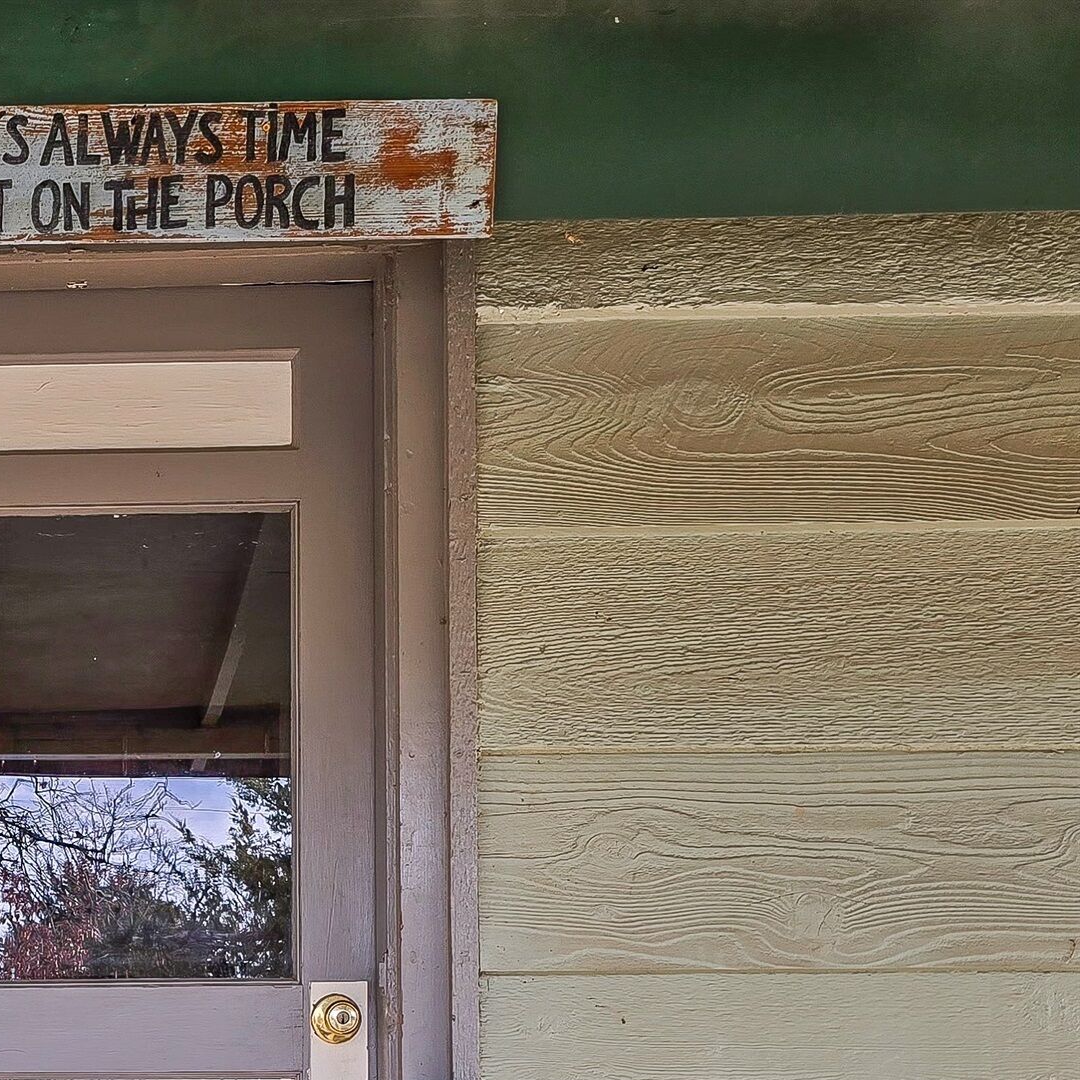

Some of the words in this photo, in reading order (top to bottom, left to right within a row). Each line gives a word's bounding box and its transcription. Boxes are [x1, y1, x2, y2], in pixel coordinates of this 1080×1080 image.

[40, 109, 223, 166] ALWAYS
[30, 179, 91, 233] ON
[103, 174, 188, 231] THE
[205, 173, 356, 231] PORCH
